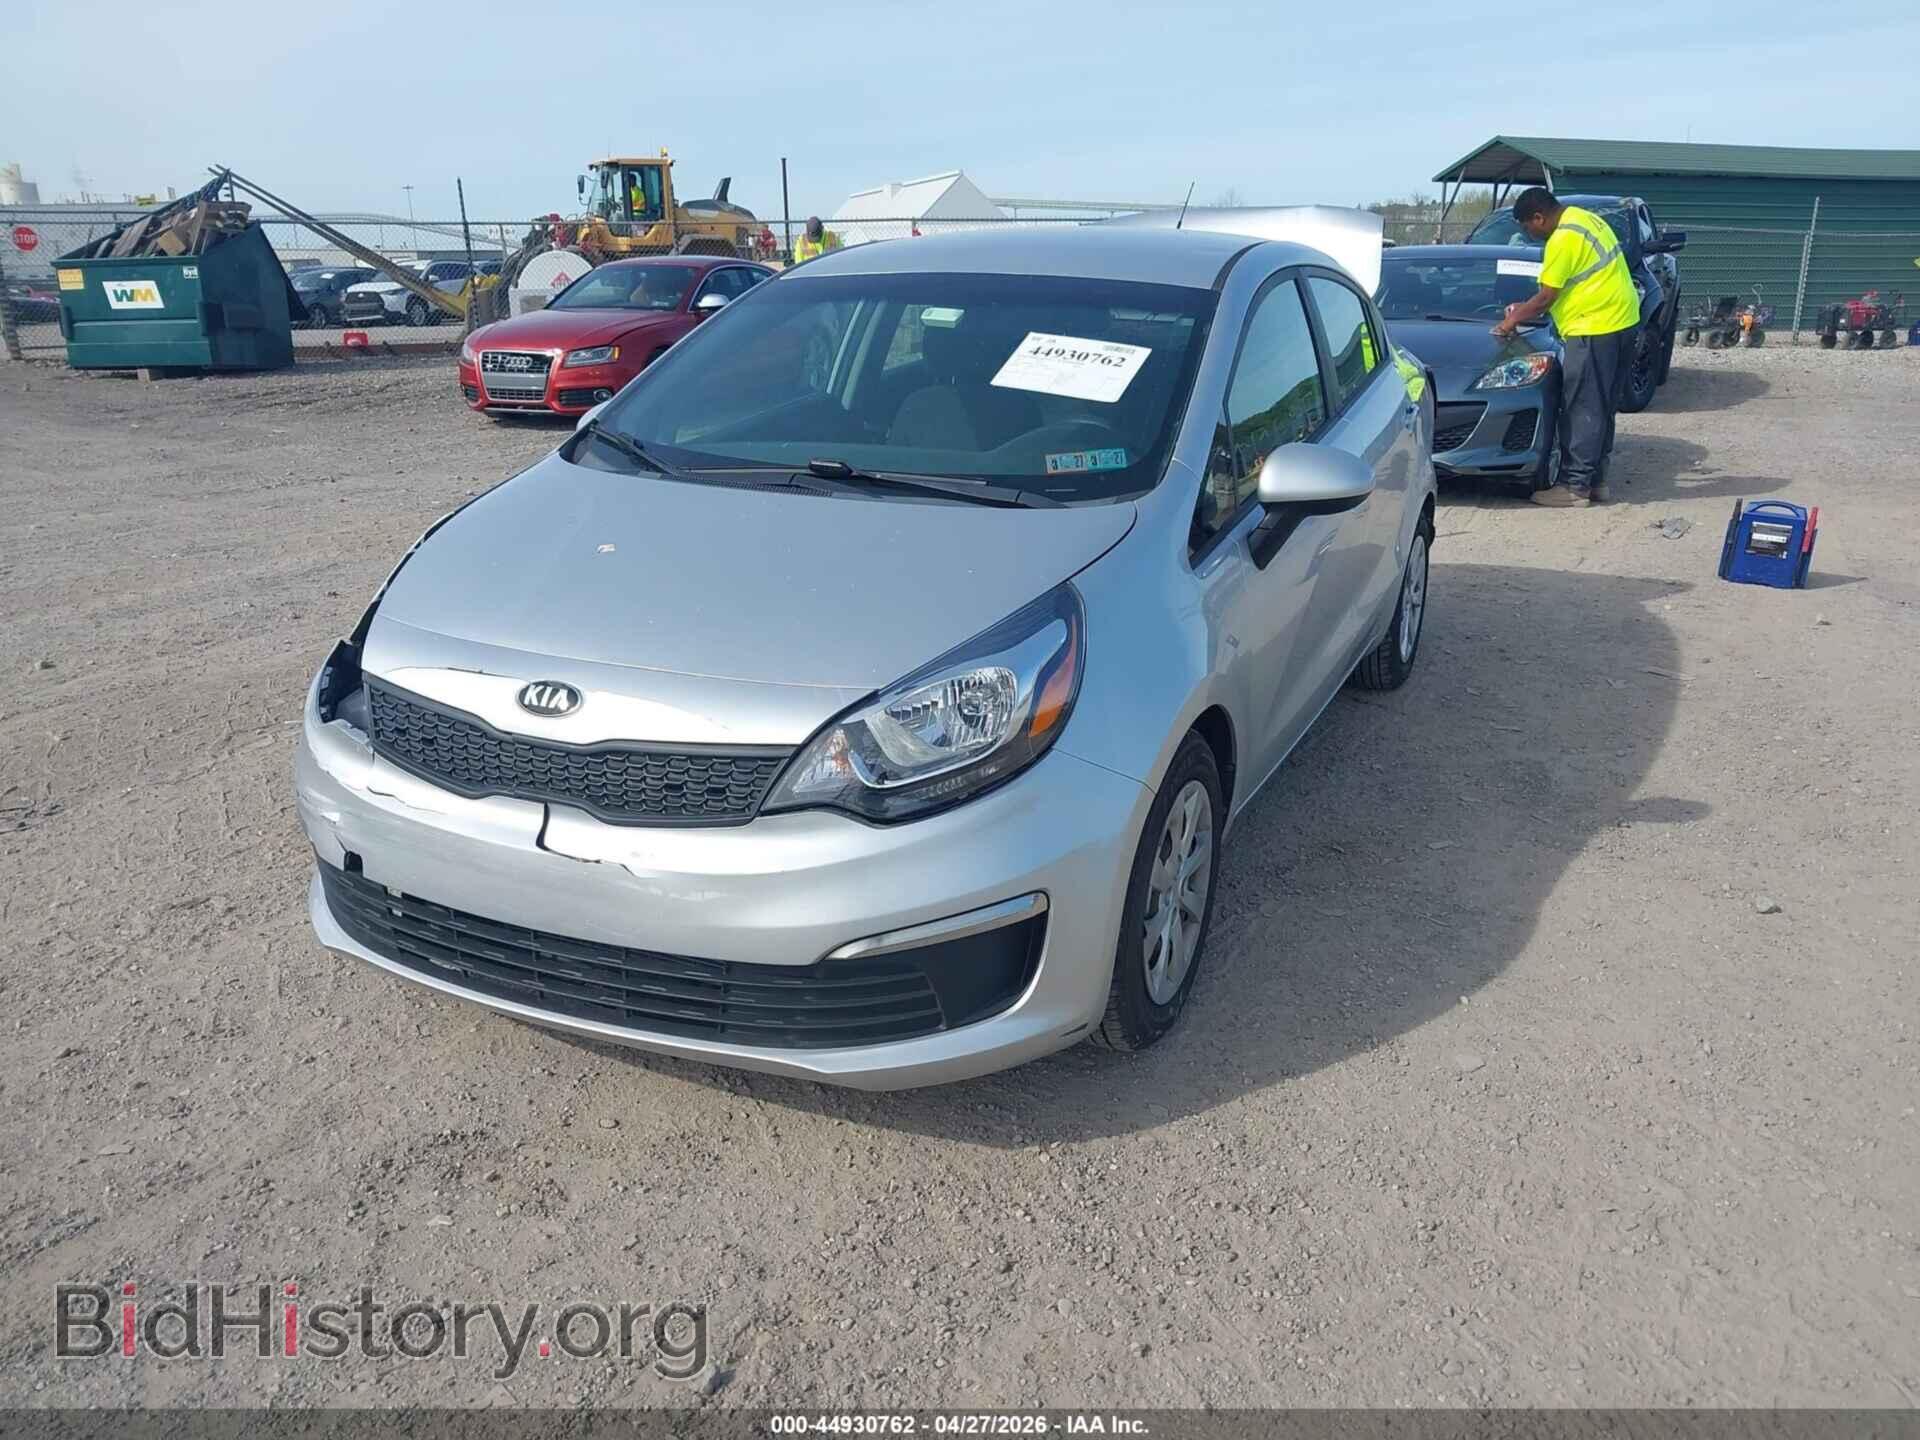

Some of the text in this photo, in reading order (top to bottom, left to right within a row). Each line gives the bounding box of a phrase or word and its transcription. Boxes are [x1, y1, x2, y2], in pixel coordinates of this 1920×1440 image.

[112, 288, 155, 302] WM
[1029, 346, 1127, 367] 44930762
[523, 684, 569, 711] KIA
